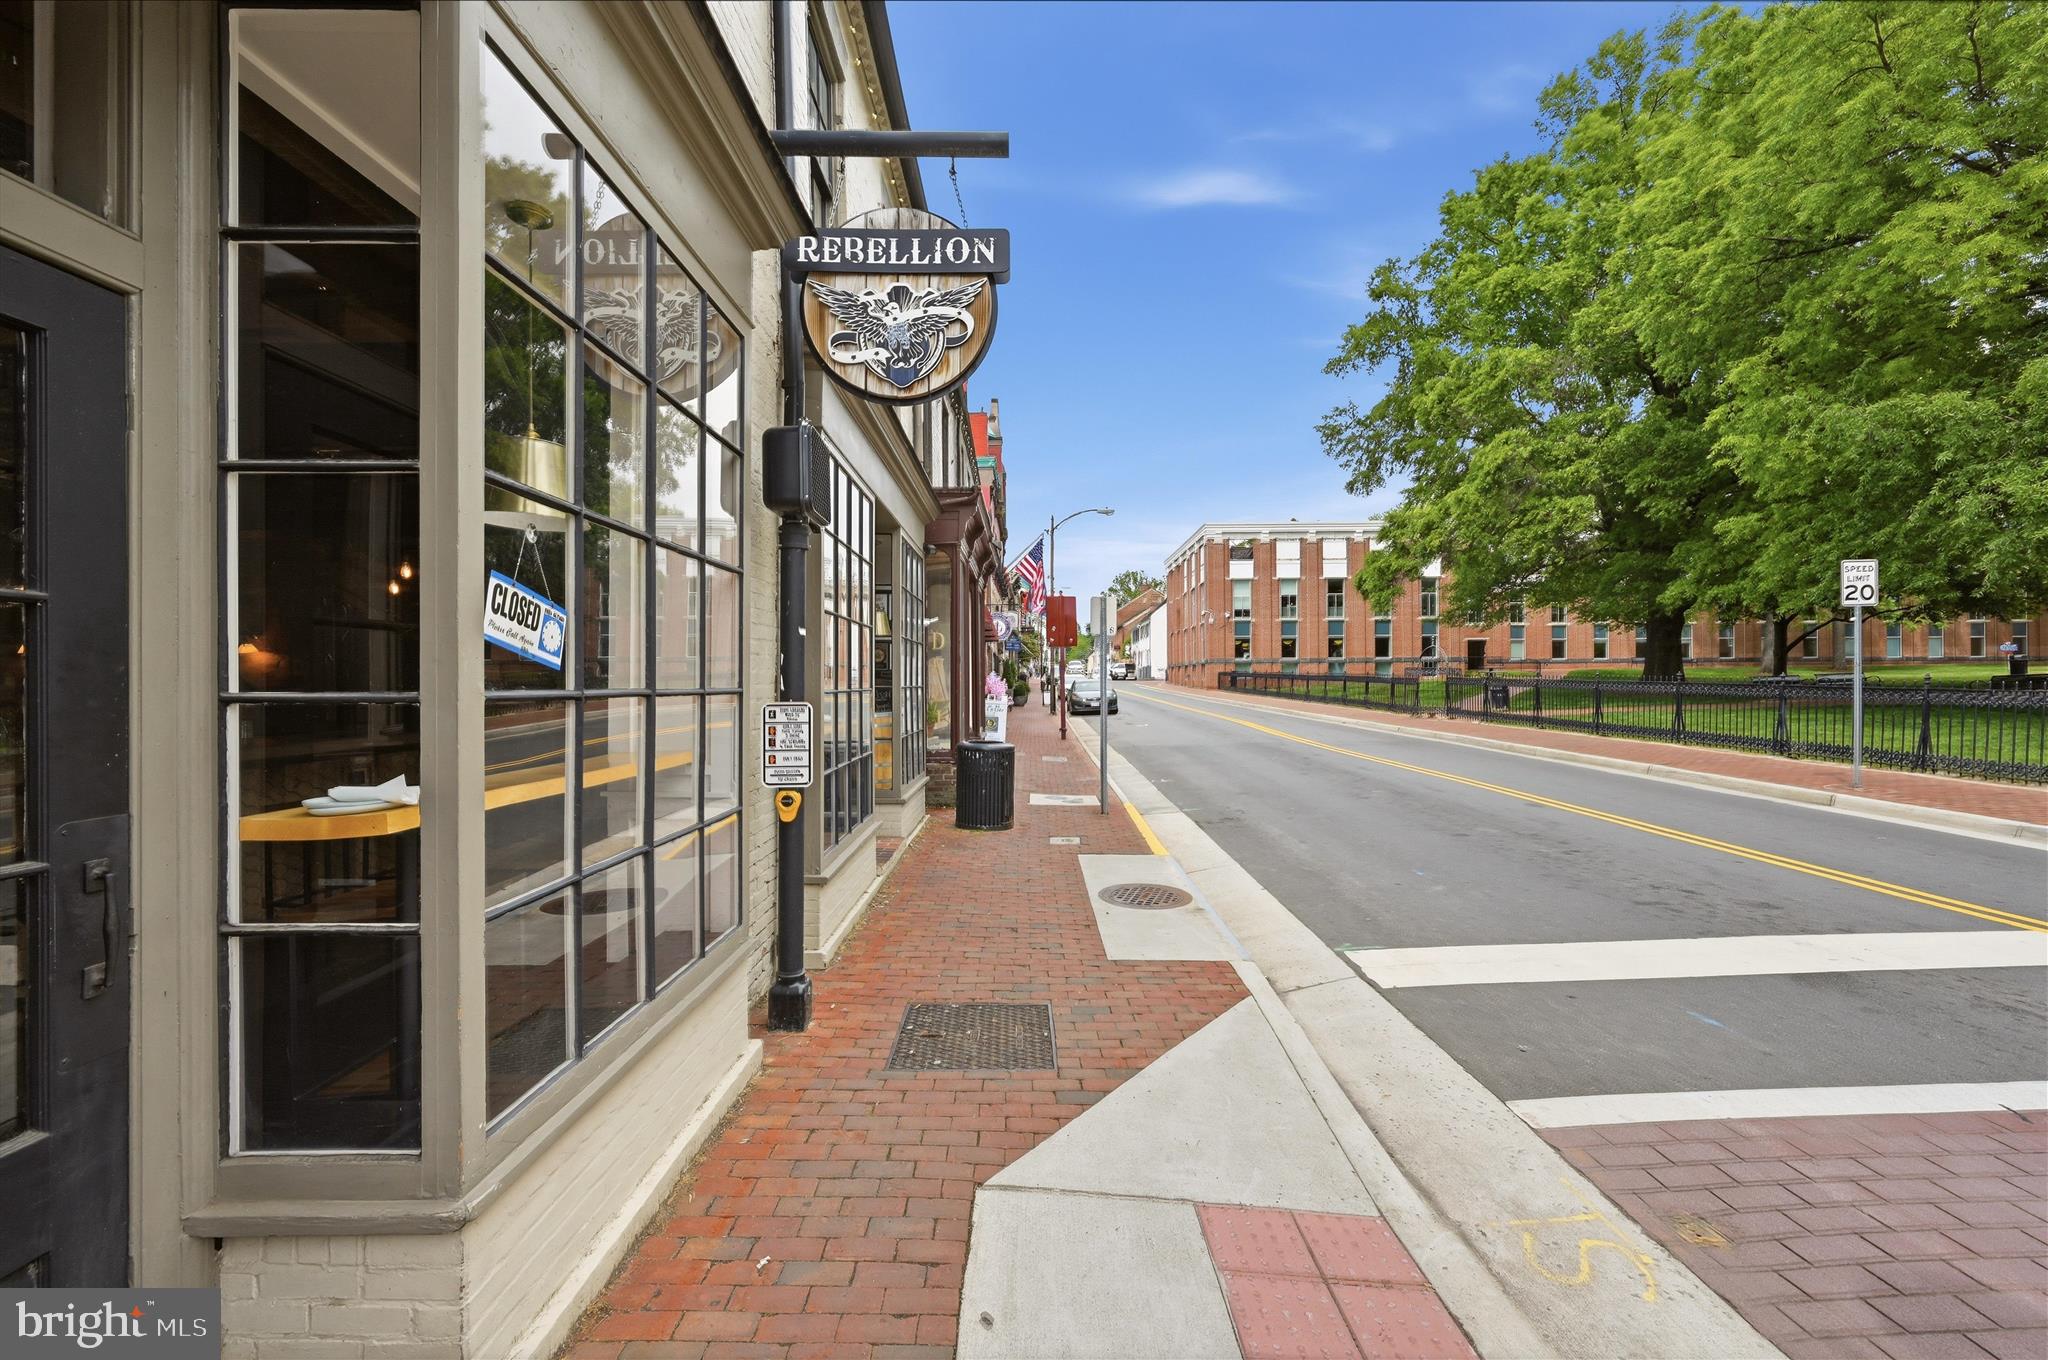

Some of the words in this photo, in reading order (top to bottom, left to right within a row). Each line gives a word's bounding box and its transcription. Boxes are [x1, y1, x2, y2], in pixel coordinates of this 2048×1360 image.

[797, 236, 996, 265] REBELLION
[1845, 565, 1874, 573] SPEED
[1844, 584, 1874, 601] 20
[491, 583, 542, 632] CLOSED
